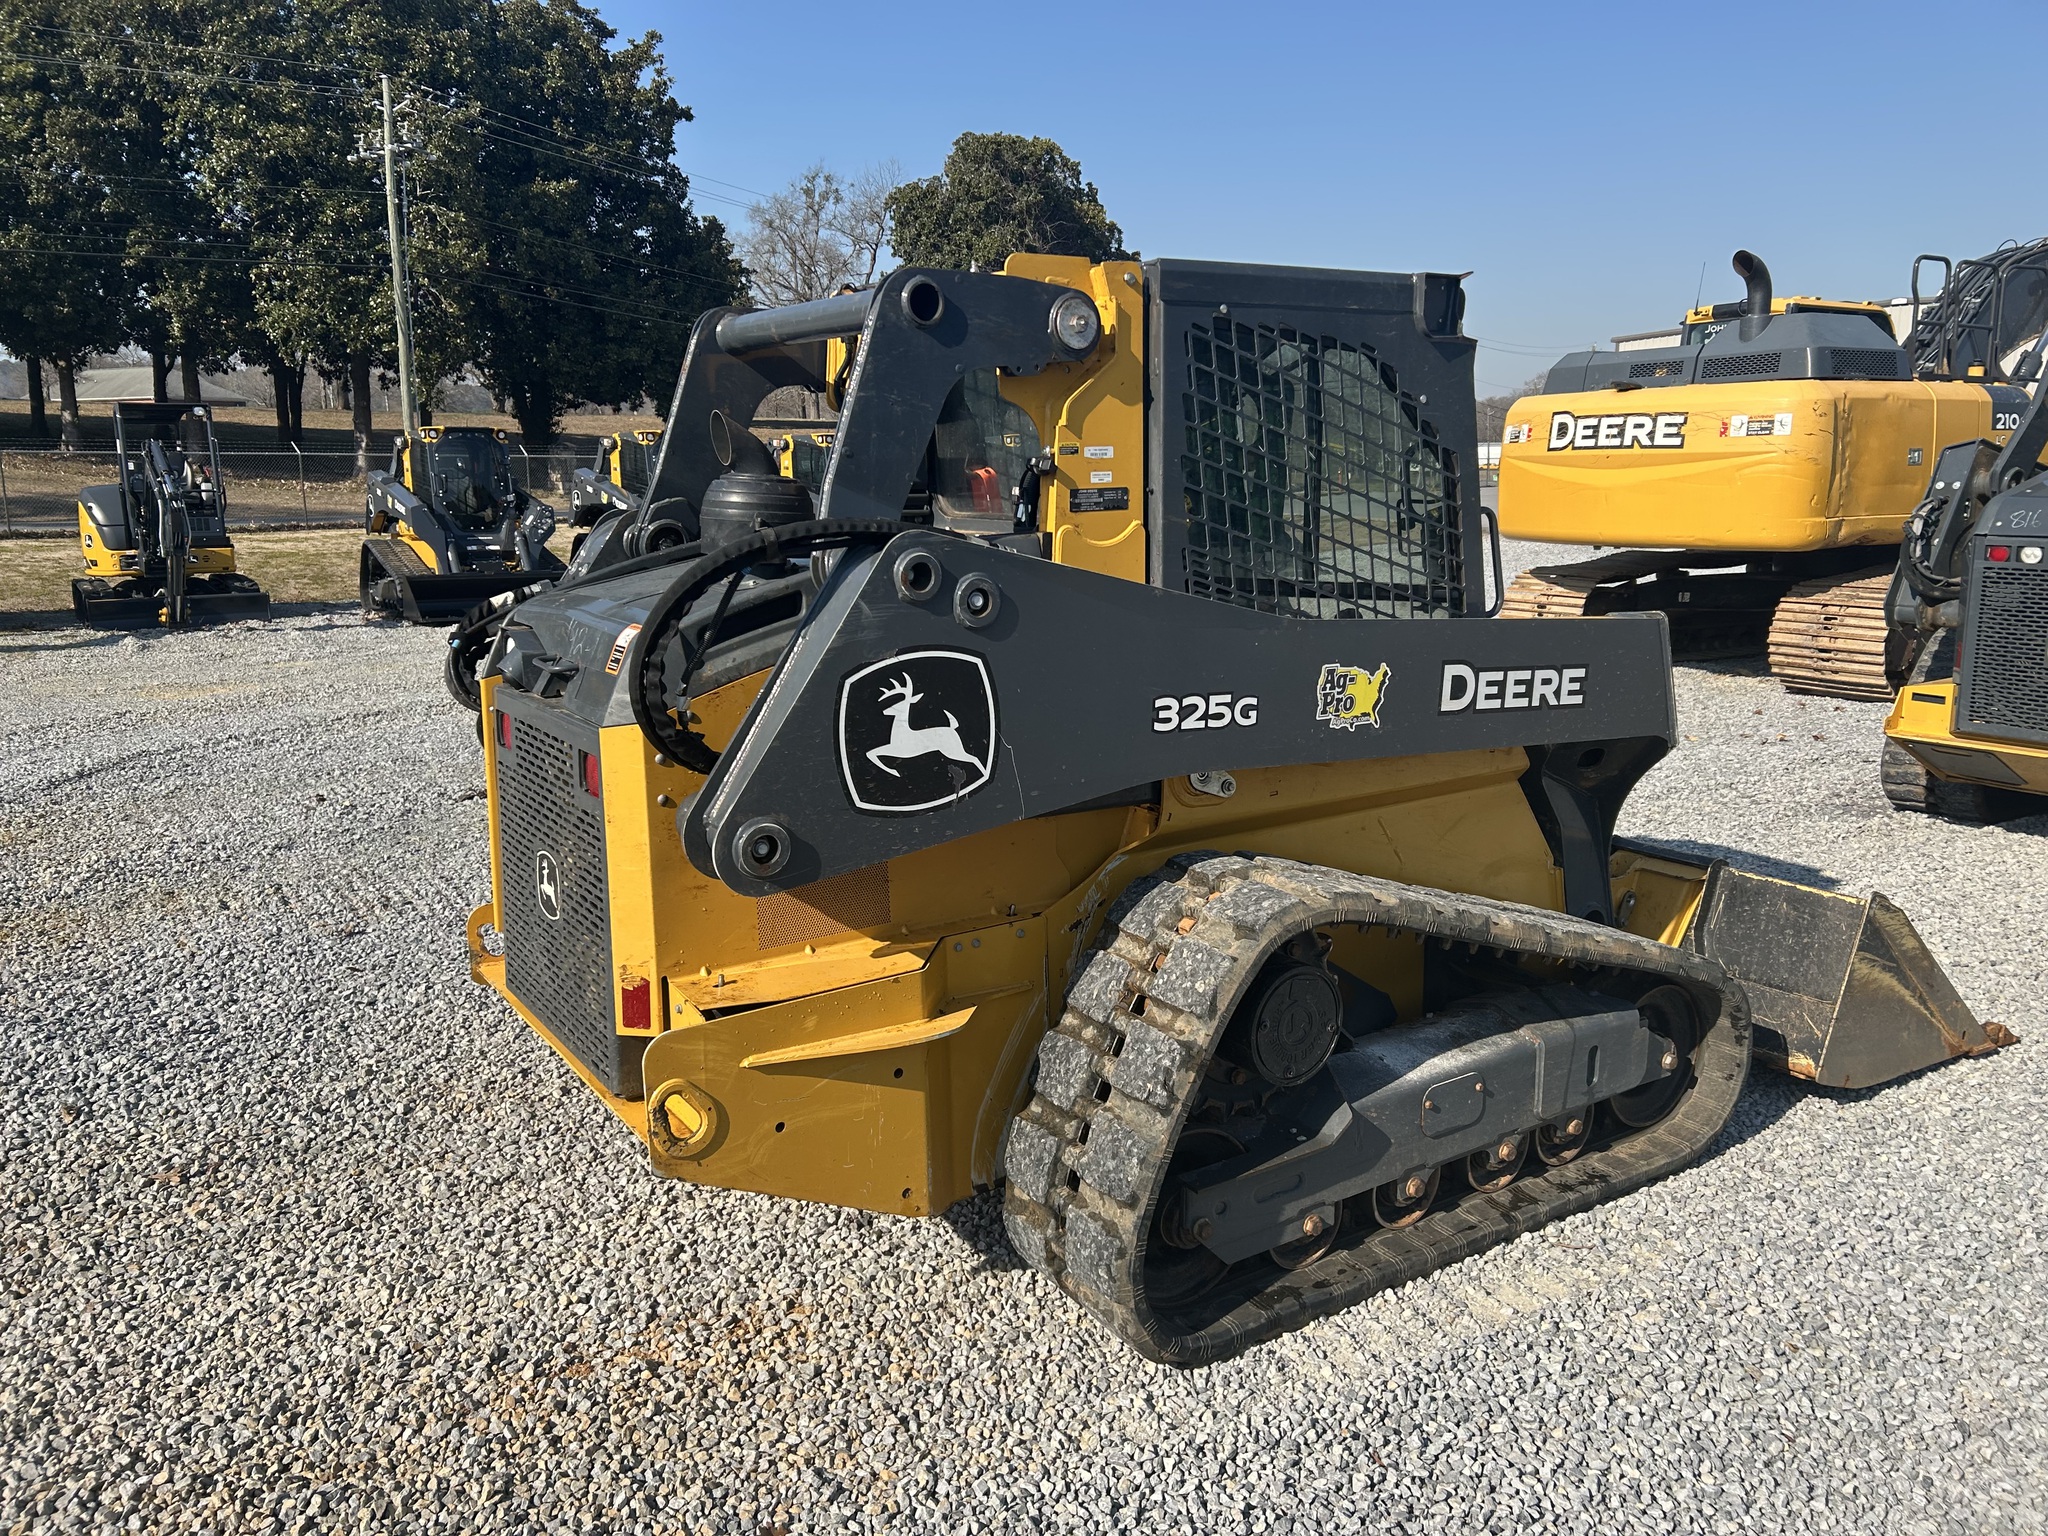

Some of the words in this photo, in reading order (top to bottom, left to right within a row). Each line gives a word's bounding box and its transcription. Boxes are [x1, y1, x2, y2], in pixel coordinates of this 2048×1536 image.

[1705, 324, 1727, 333] JOH
[1549, 412, 1685, 449] DEERE
[1321, 669, 1356, 695] Ag-
[1440, 664, 1586, 712] DEERE
[1153, 694, 1258, 731] 325G
[1320, 693, 1355, 716] Pro
[1332, 716, 1371, 726] AgProCo.com
